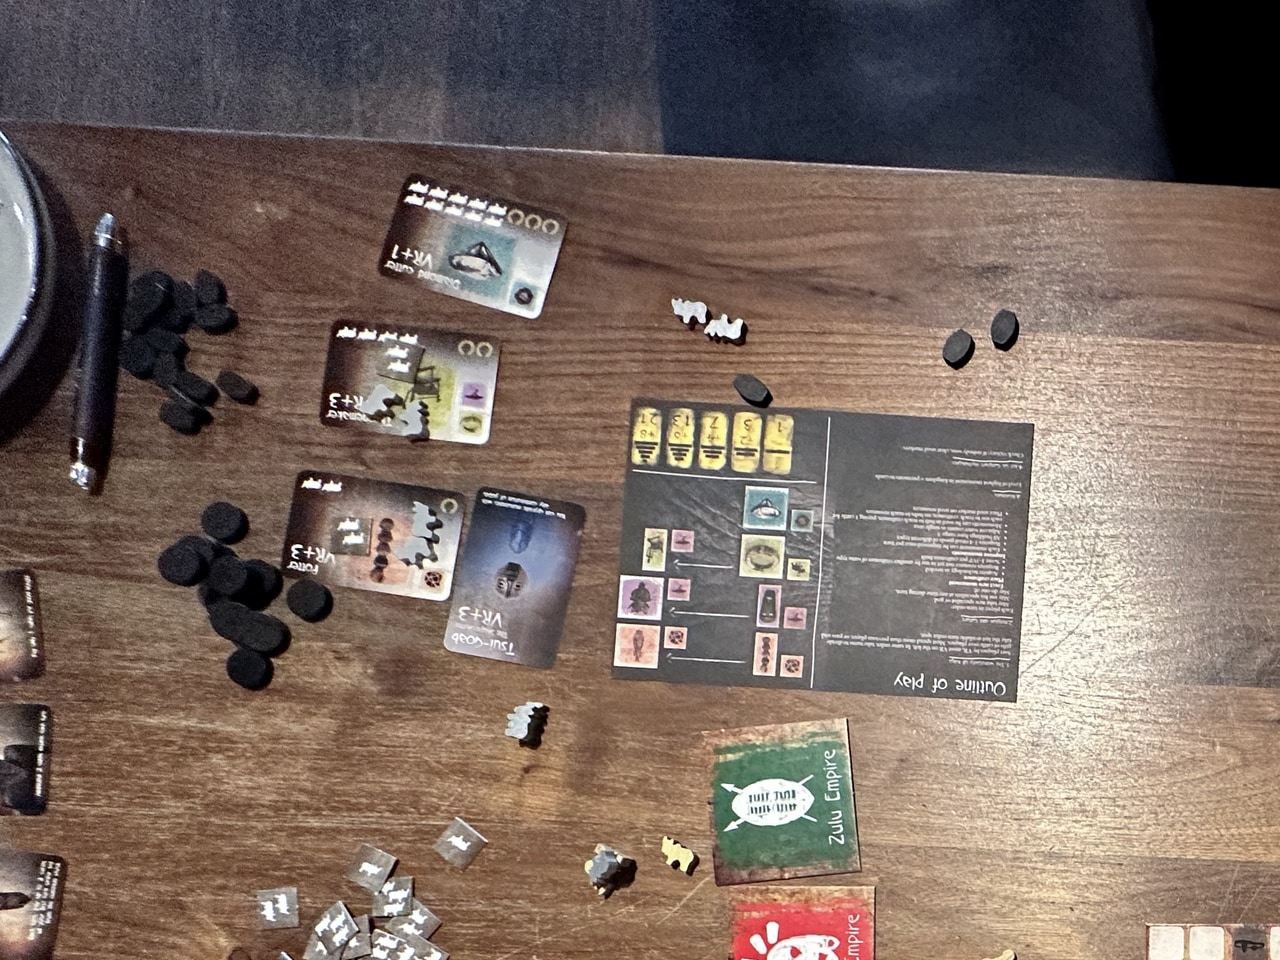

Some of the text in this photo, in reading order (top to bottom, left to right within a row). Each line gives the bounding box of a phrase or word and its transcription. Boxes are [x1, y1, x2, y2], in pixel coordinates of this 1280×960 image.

[328, 392, 364, 410] R+3
[290, 543, 336, 565] VR+3
[286, 560, 319, 575] Potter
[458, 606, 503, 628] VR+3
[451, 633, 515, 656] Tsui-Goab
[893, 671, 1007, 697] Outline of play
[822, 749, 845, 845] Zulu Empire
